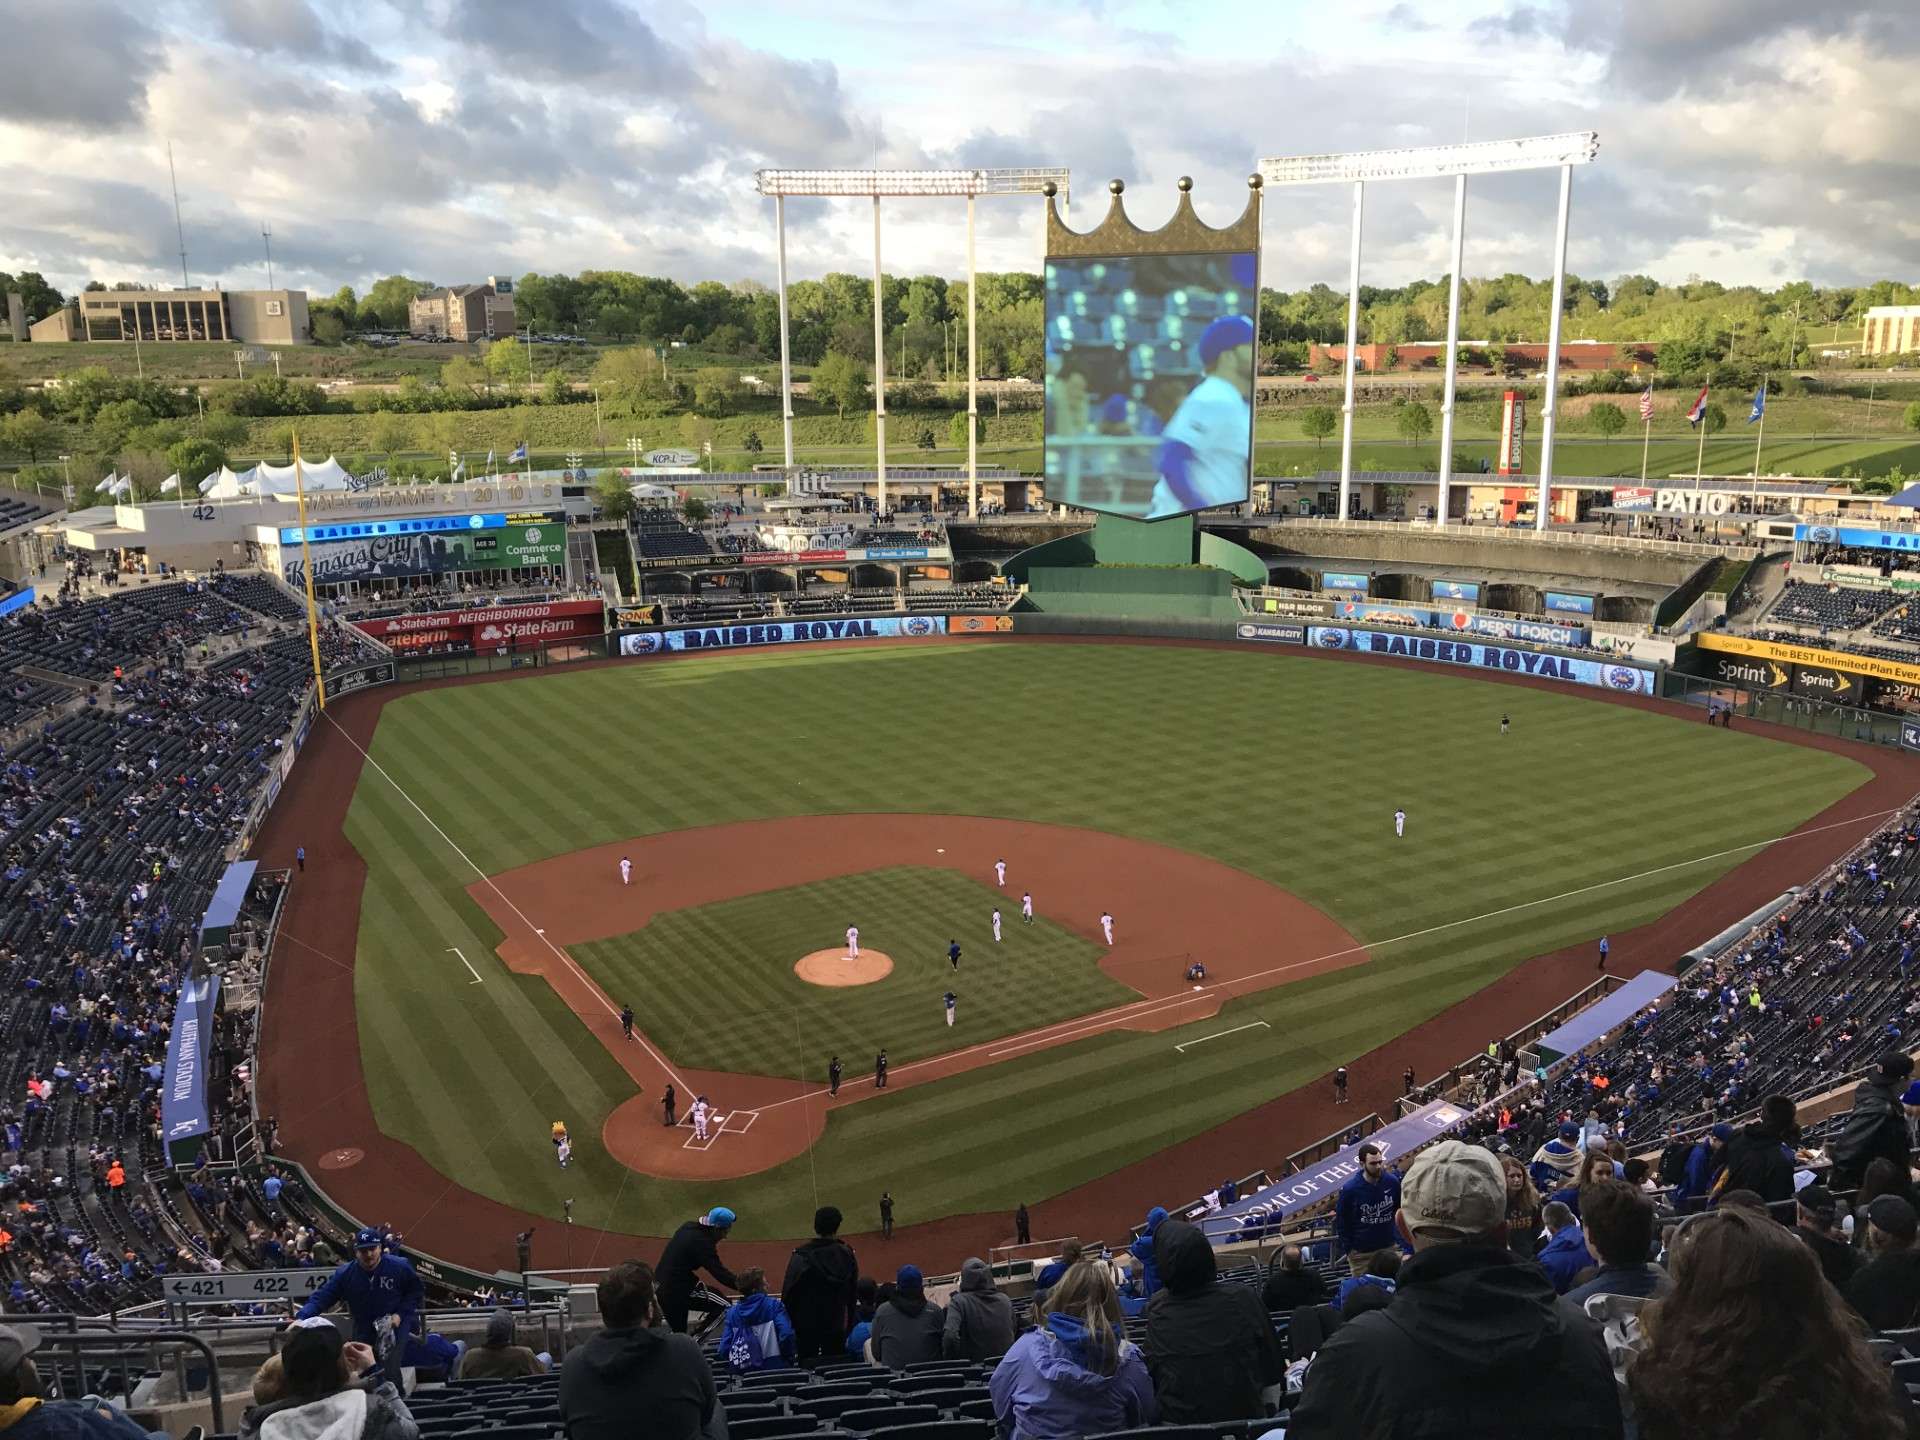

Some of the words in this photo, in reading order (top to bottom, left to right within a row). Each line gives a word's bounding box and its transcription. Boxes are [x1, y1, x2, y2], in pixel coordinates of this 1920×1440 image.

[1512, 405, 1521, 463] BOULEVARD
[343, 465, 388, 492] Royals
[378, 488, 435, 508] FAME
[473, 487, 492, 502] 20
[510, 485, 523, 501] 10
[543, 484, 552, 498] 5
[1616, 488, 1639, 499] PRICE
[1614, 497, 1651, 508] CHOPPER
[1656, 489, 1727, 515] PATIO
[192, 505, 214, 520] 42
[314, 524, 387, 538] RAISED
[399, 519, 460, 532] ROYAL
[370, 534, 412, 563] City
[506, 543, 561, 555] Commerce
[522, 553, 549, 564] Bank
[713, 556, 738, 565] ARGOSY
[1832, 574, 1873, 585] Commerce
[1874, 578, 1893, 587] Bank
[458, 606, 550, 624] NEIGHBORHOOD
[619, 610, 652, 621] SONIC
[1278, 602, 1295, 610] H&R
[1297, 603, 1324, 613] BLOCK
[684, 624, 782, 648] RAISED
[794, 620, 878, 640] ROYAL
[1285, 631, 1301, 639] CITY
[1479, 619, 1517, 636] PEPSI
[1521, 628, 1571, 643] PORCH
[1613, 636, 1635, 651] Ivy
[1721, 640, 1743, 650] Sprint
[1371, 634, 1472, 664] RAISED
[1484, 647, 1576, 680] ROYAL
[1769, 646, 1787, 658] The
[1789, 649, 1815, 662] BEST
[1817, 655, 1868, 671] Unlimited
[1870, 664, 1892, 676] Plan
[1719, 660, 1766, 684] Sprint
[1800, 671, 1835, 689] Sprint
[178, 1018, 199, 1060] KAUFFMAN
[173, 1061, 195, 1102] STADIUM
[1291, 1182, 1320, 1203] OF
[1314, 1161, 1357, 1186] THE
[1360, 1194, 1393, 1216] Royals
[191, 1280, 225, 1295] 421
[253, 1278, 289, 1293] 422
[305, 1275, 334, 1291] 42
[380, 1276, 394, 1289] KC
